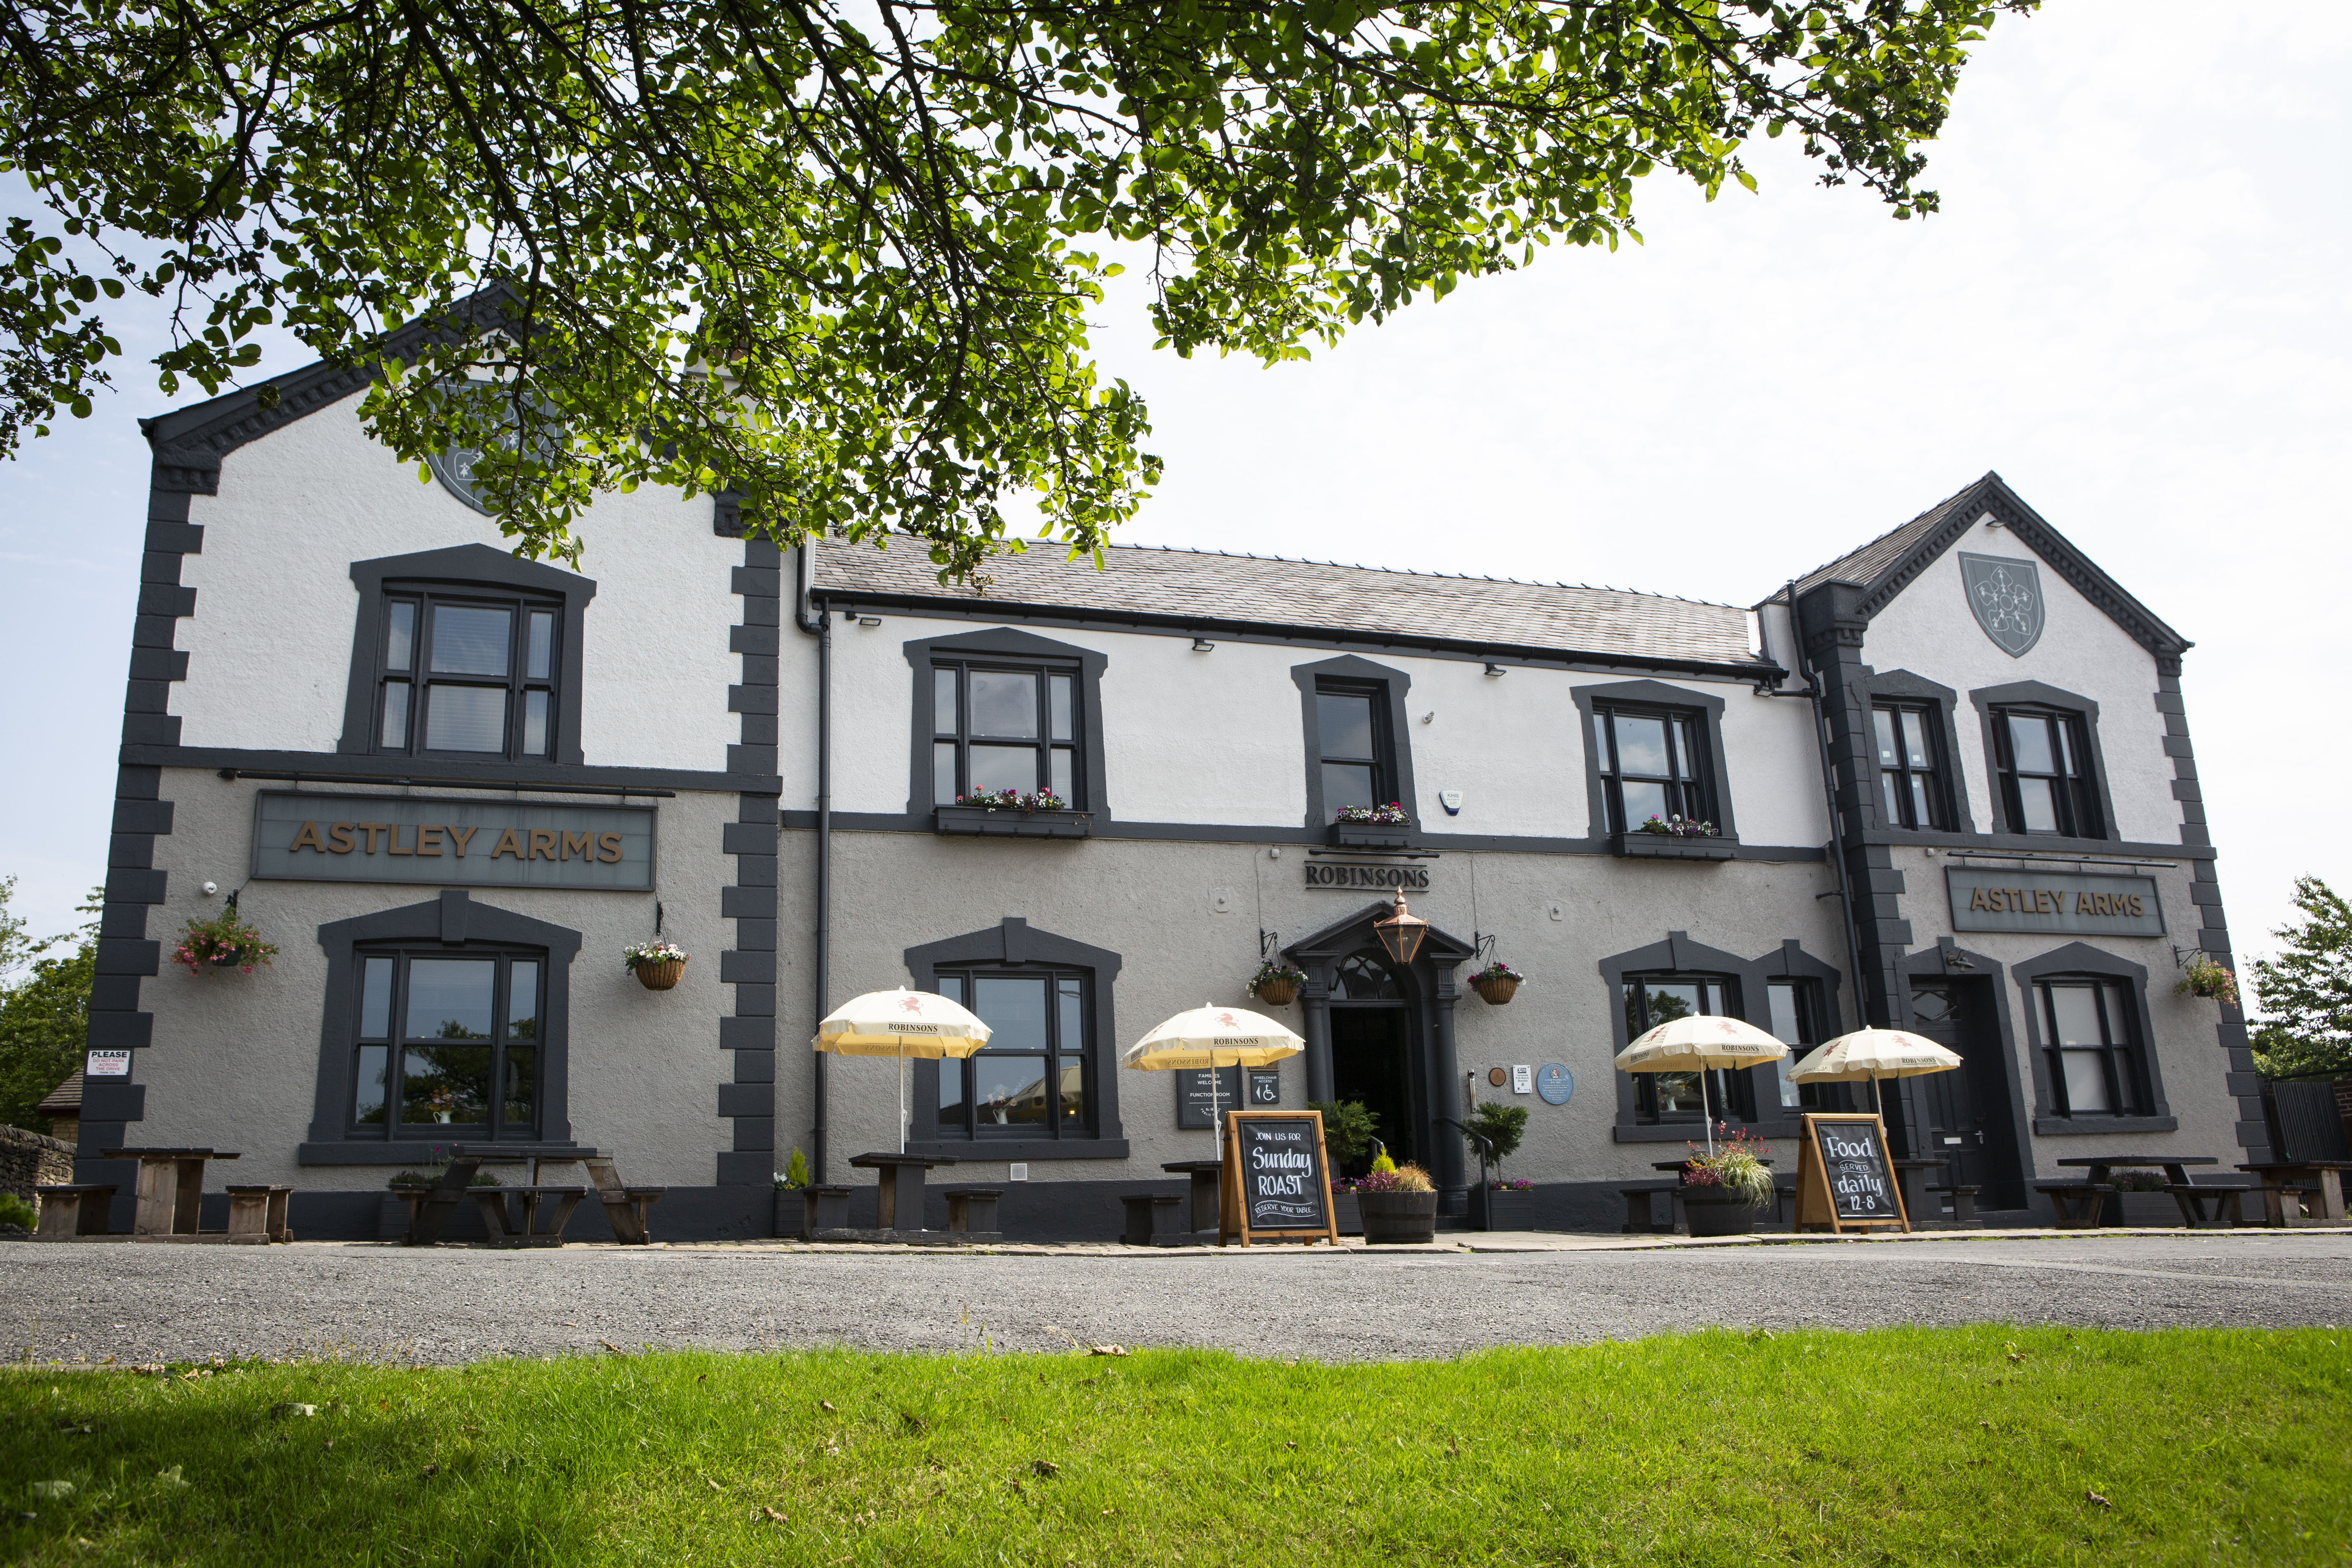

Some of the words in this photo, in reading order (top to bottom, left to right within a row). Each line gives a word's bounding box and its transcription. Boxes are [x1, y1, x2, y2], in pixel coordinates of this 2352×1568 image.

[290, 820, 478, 857] ASTLEY
[491, 828, 623, 863] ARMS
[1305, 866, 1429, 888] ROBINSONS
[1971, 887, 2066, 913] ASTLEY
[2077, 891, 2145, 917] ARMS
[888, 1023, 937, 1032] ROBINSONS
[1214, 1037, 1258, 1045] ROBINSONS
[1631, 1051, 1650, 1061] ROBINSONS
[1200, 1108, 1211, 1116] PUBLIC
[1256, 1132, 1272, 1141] JOIN
[1275, 1132, 1286, 1141] US
[1826, 1137, 1874, 1158] Food
[1252, 1146, 1312, 1178] Sunday
[1839, 1163, 1868, 1171] SERVED
[1258, 1175, 1303, 1196] ROAST
[1838, 1175, 1883, 1197] daily
[1255, 1204, 1278, 1214] RESERVE
[1850, 1195, 1875, 1211] 12-8
